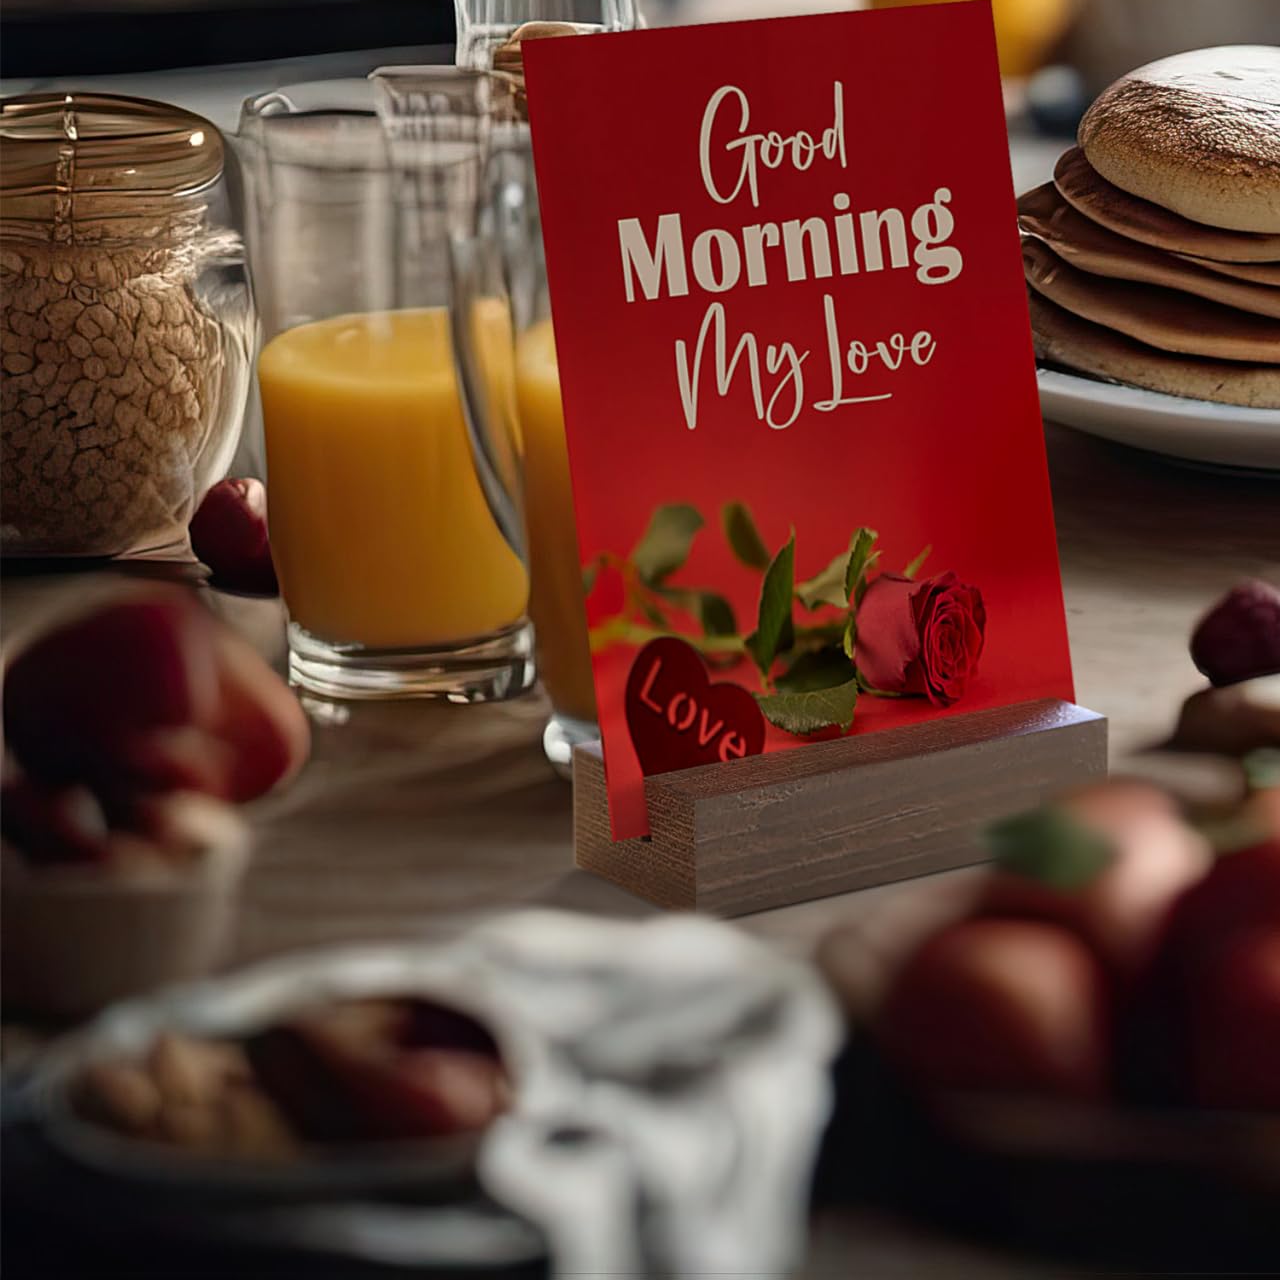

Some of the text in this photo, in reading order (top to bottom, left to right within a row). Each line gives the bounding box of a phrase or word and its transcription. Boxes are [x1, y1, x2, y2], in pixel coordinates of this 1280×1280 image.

[700, 81, 847, 207] Good
[617, 187, 963, 303] Morning
[675, 294, 937, 430] My Love
[640, 657, 747, 762] Love
